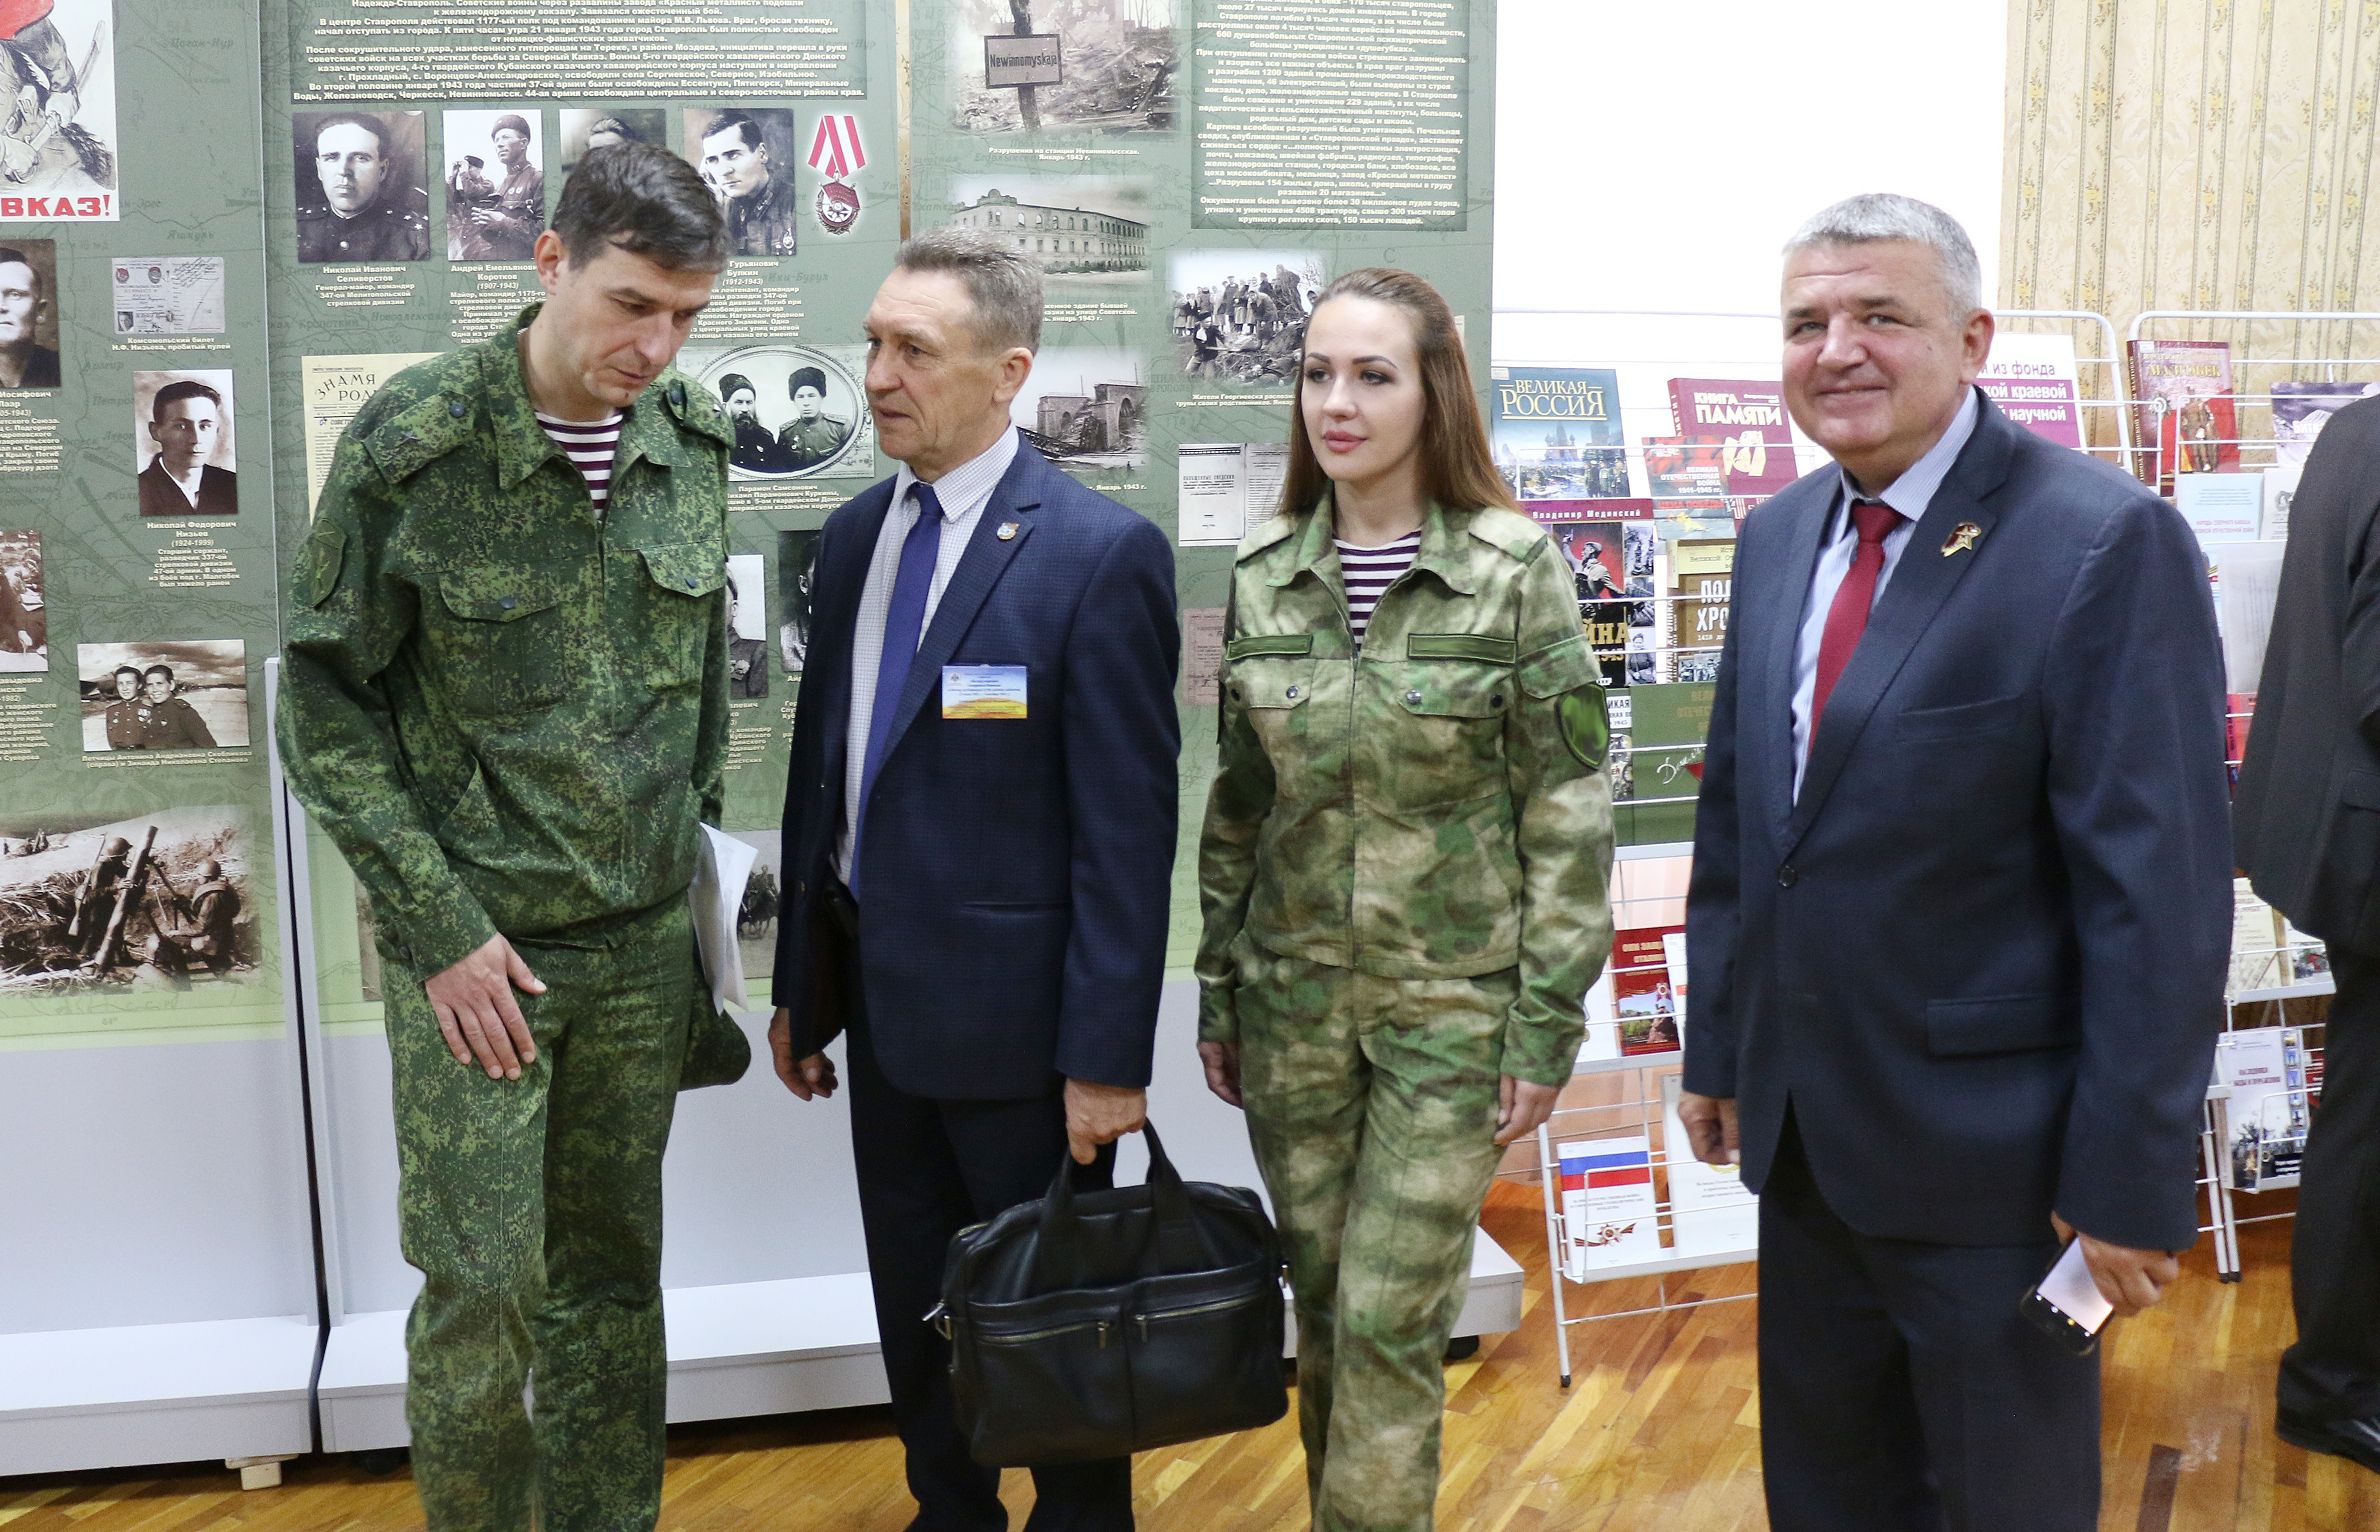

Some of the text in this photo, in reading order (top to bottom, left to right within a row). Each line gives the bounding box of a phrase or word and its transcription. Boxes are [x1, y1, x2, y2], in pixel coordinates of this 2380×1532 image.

[1, 195, 110, 217] ВКАЗ!
[1993, 360, 2055, 379] из фонда
[315, 373, 375, 400] ЗНАМЯ
[1515, 380, 1588, 394] ВЕЛИКАЯ
[2011, 383, 2067, 399] краевой
[1500, 389, 1606, 416] РОССИЯ
[1694, 392, 1739, 405] КНИГА
[1695, 405, 1783, 425] ПАМЯТИ
[2010, 406, 2066, 424] научной
[1533, 510, 1582, 519] Владимир
